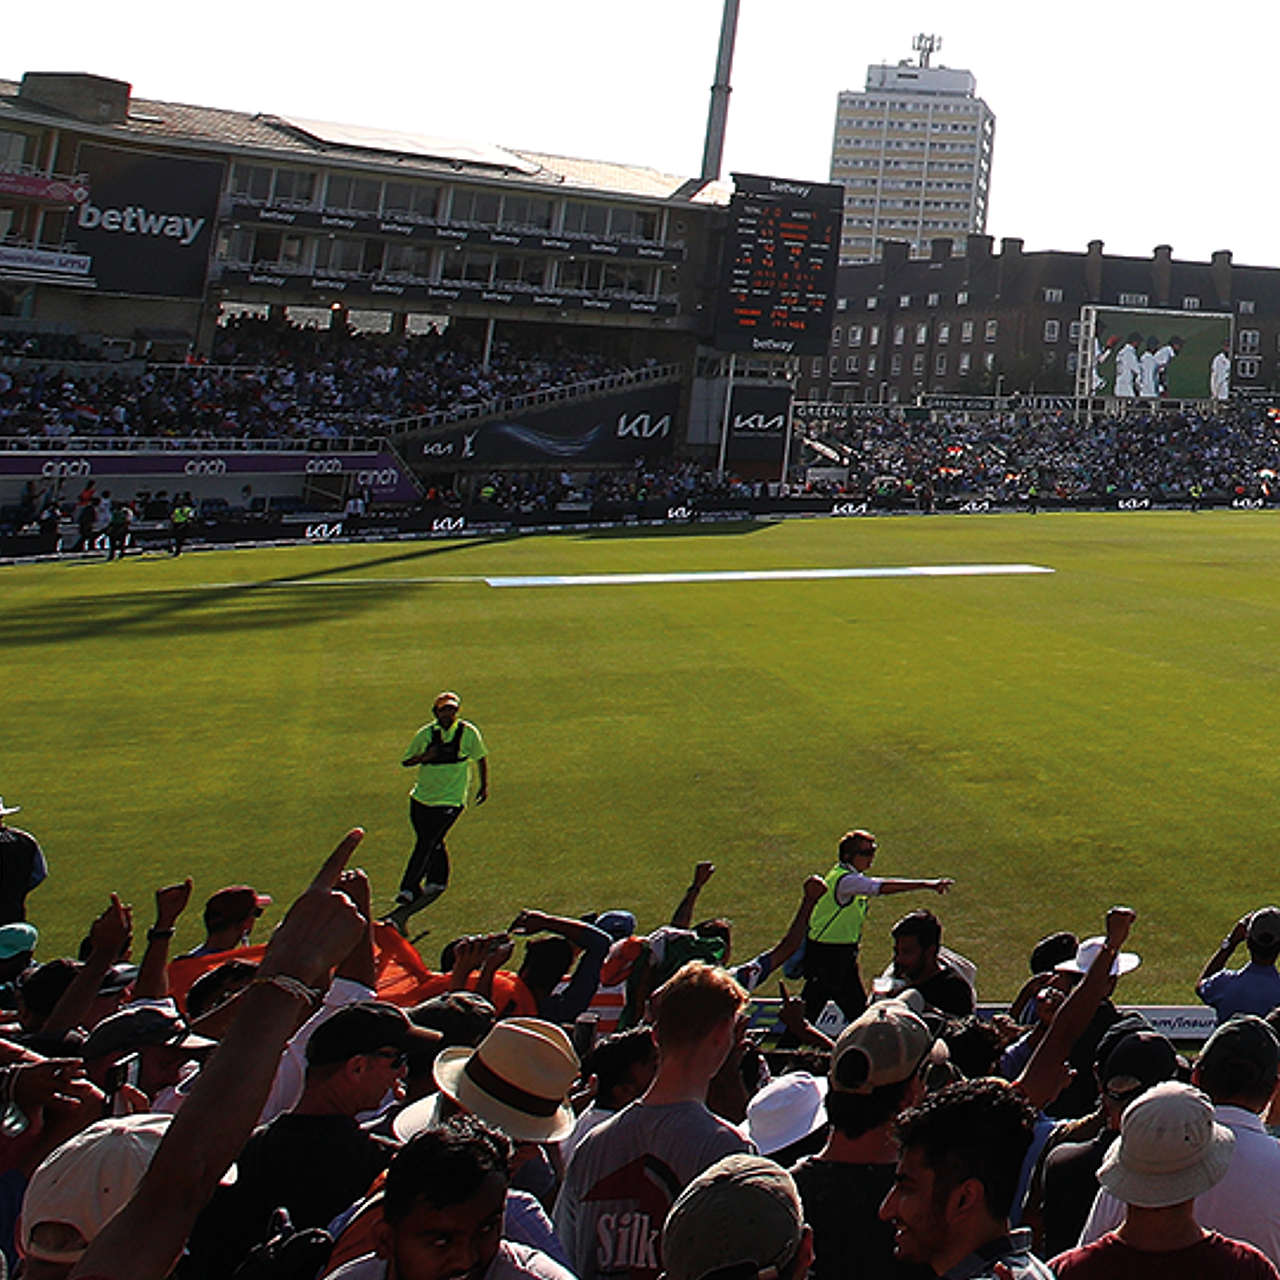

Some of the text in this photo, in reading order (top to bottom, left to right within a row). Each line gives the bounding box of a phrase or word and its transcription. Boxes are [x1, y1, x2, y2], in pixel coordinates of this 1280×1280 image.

[770, 181, 812, 198] betway
[78, 200, 206, 245] betway
[260, 209, 296, 224] betway
[322, 215, 356, 228] betway
[381, 221, 414, 235] betway
[437, 227, 468, 240] betway
[490, 233, 520, 245] betway
[542, 238, 570, 250] betway
[591, 243, 619, 254] betway
[638, 247, 665, 258] betway
[249, 274, 286, 287] betway
[312, 278, 346, 291] betway
[372, 283, 404, 296] betway
[428, 287, 460, 299] betway
[482, 291, 513, 302] betway
[534, 295, 562, 306] betway
[583, 298, 611, 310] betway
[630, 302, 657, 313] betway
[753, 337, 795, 352] betway
[616, 412, 672, 438] KIA
[734, 413, 784, 429] KIA
[42, 458, 91, 476] cinch
[185, 458, 226, 476] cinch
[306, 458, 342, 474] cinch
[358, 467, 399, 485] cinch
[432, 516, 465, 530] KIA
[305, 523, 342, 538] KIA
[598, 1213, 660, 1268] Silk
